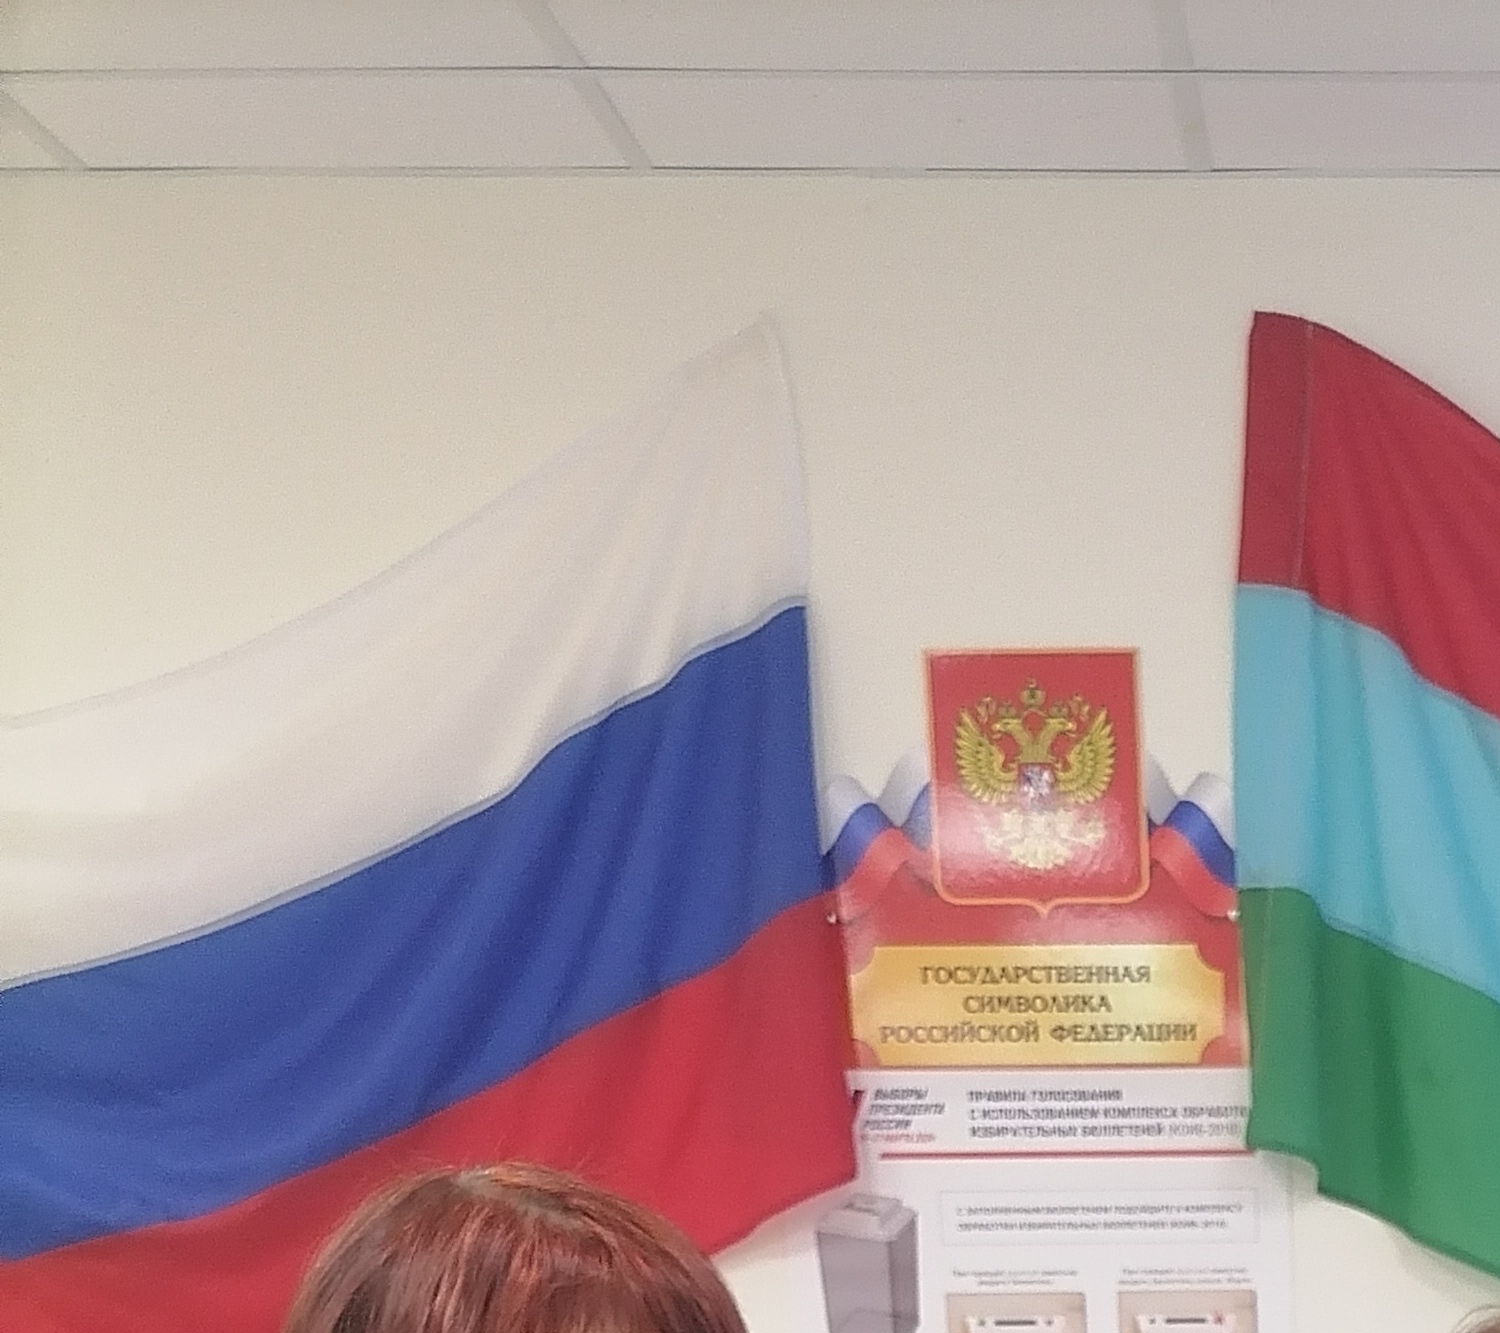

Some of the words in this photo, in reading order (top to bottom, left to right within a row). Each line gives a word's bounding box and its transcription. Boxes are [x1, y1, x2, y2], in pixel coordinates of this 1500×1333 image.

[920, 965, 1151, 985] ГОСУДАРСТВЕННАЯ
[962, 995, 1112, 1014] СИМВОЛИКА
[879, 1020, 1039, 1043] РОССИЙСКОЙ
[1050, 1023, 1197, 1044] ФЕДЕРАЦИИ
